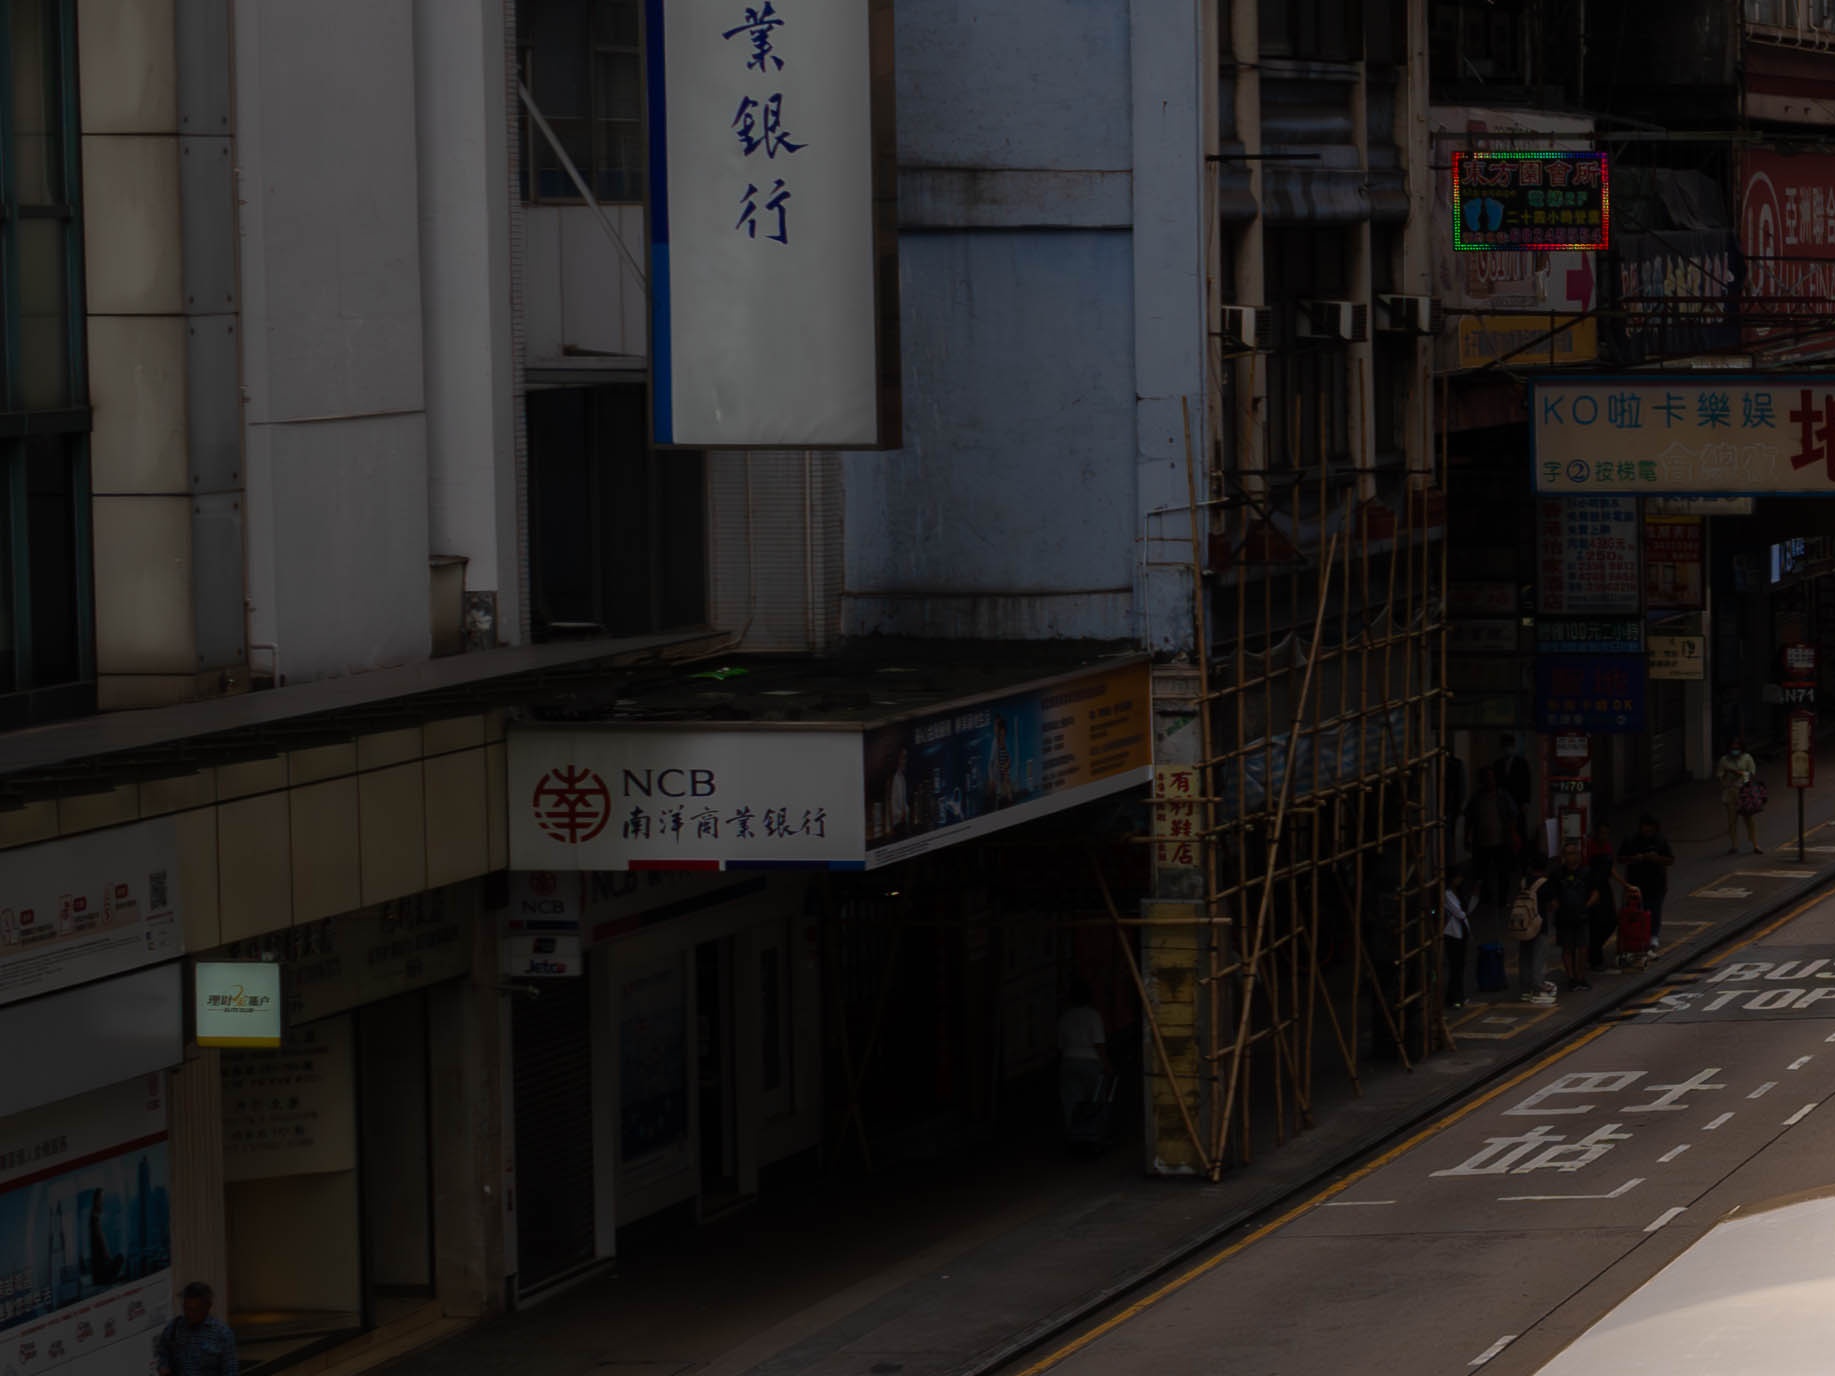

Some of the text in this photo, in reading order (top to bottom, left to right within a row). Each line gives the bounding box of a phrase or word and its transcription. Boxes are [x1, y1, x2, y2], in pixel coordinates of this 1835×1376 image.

[1783, 688, 1816, 704] N71
[622, 768, 717, 797] NCB
[620, 804, 829, 842] 南洋商業銀行
[521, 899, 566, 915] NCB
[1501, 1067, 1727, 1116] 巴士
[1428, 1122, 1634, 1178] 站
